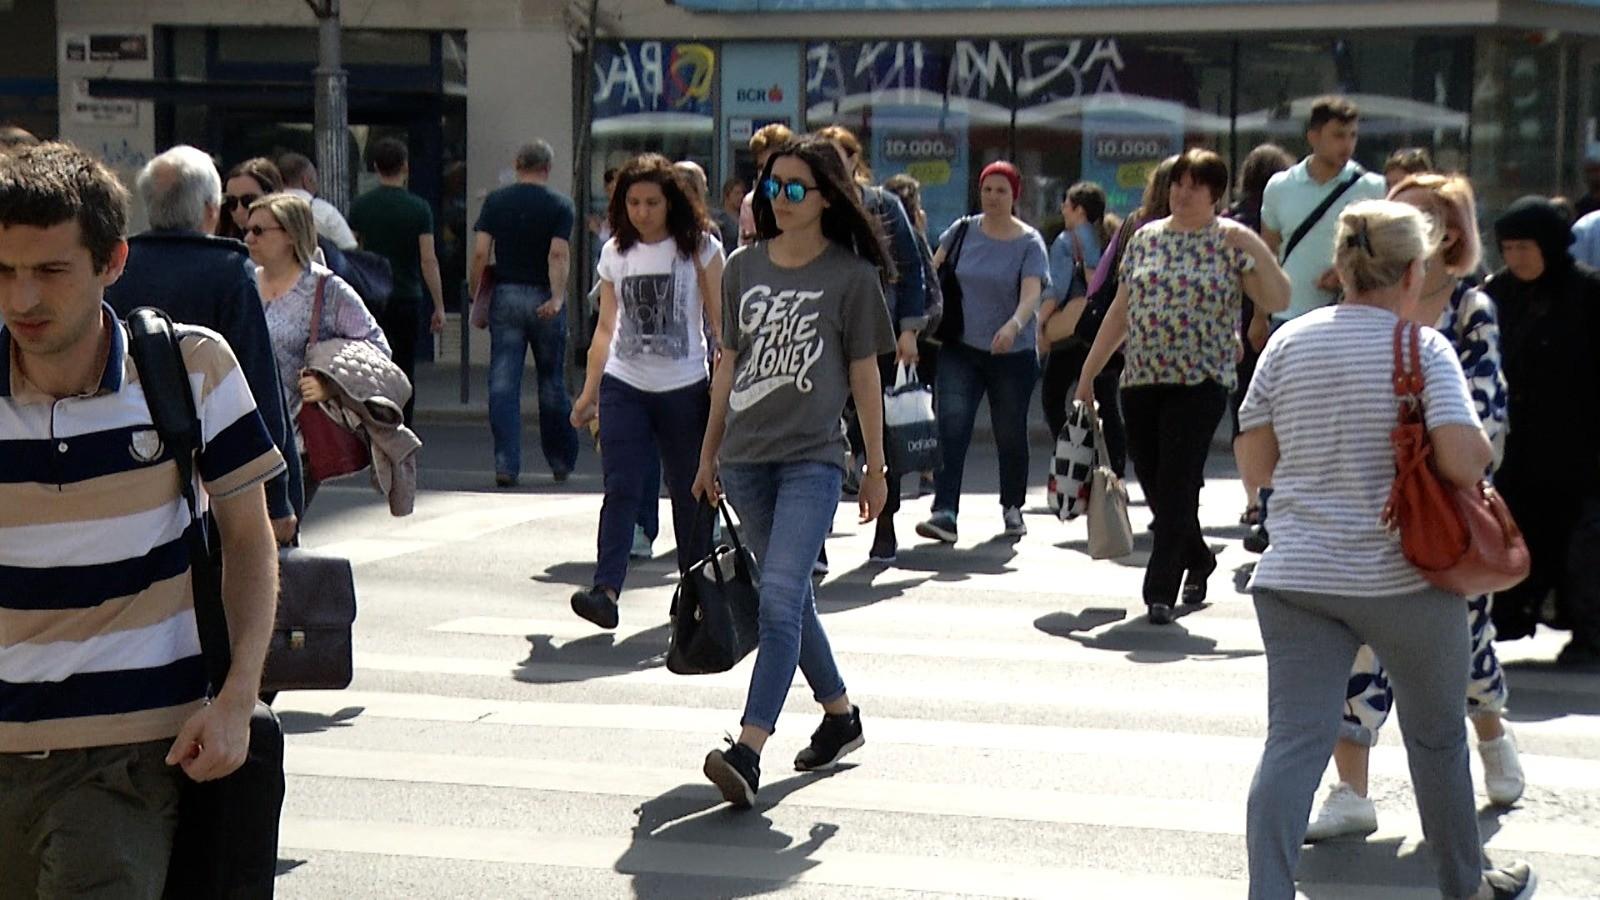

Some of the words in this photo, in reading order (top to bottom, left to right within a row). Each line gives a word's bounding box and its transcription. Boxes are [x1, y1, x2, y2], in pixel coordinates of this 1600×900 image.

[737, 87, 766, 102] BCR
[739, 285, 824, 333] GET
[759, 312, 820, 348] THE
[735, 336, 824, 393] MONEY
